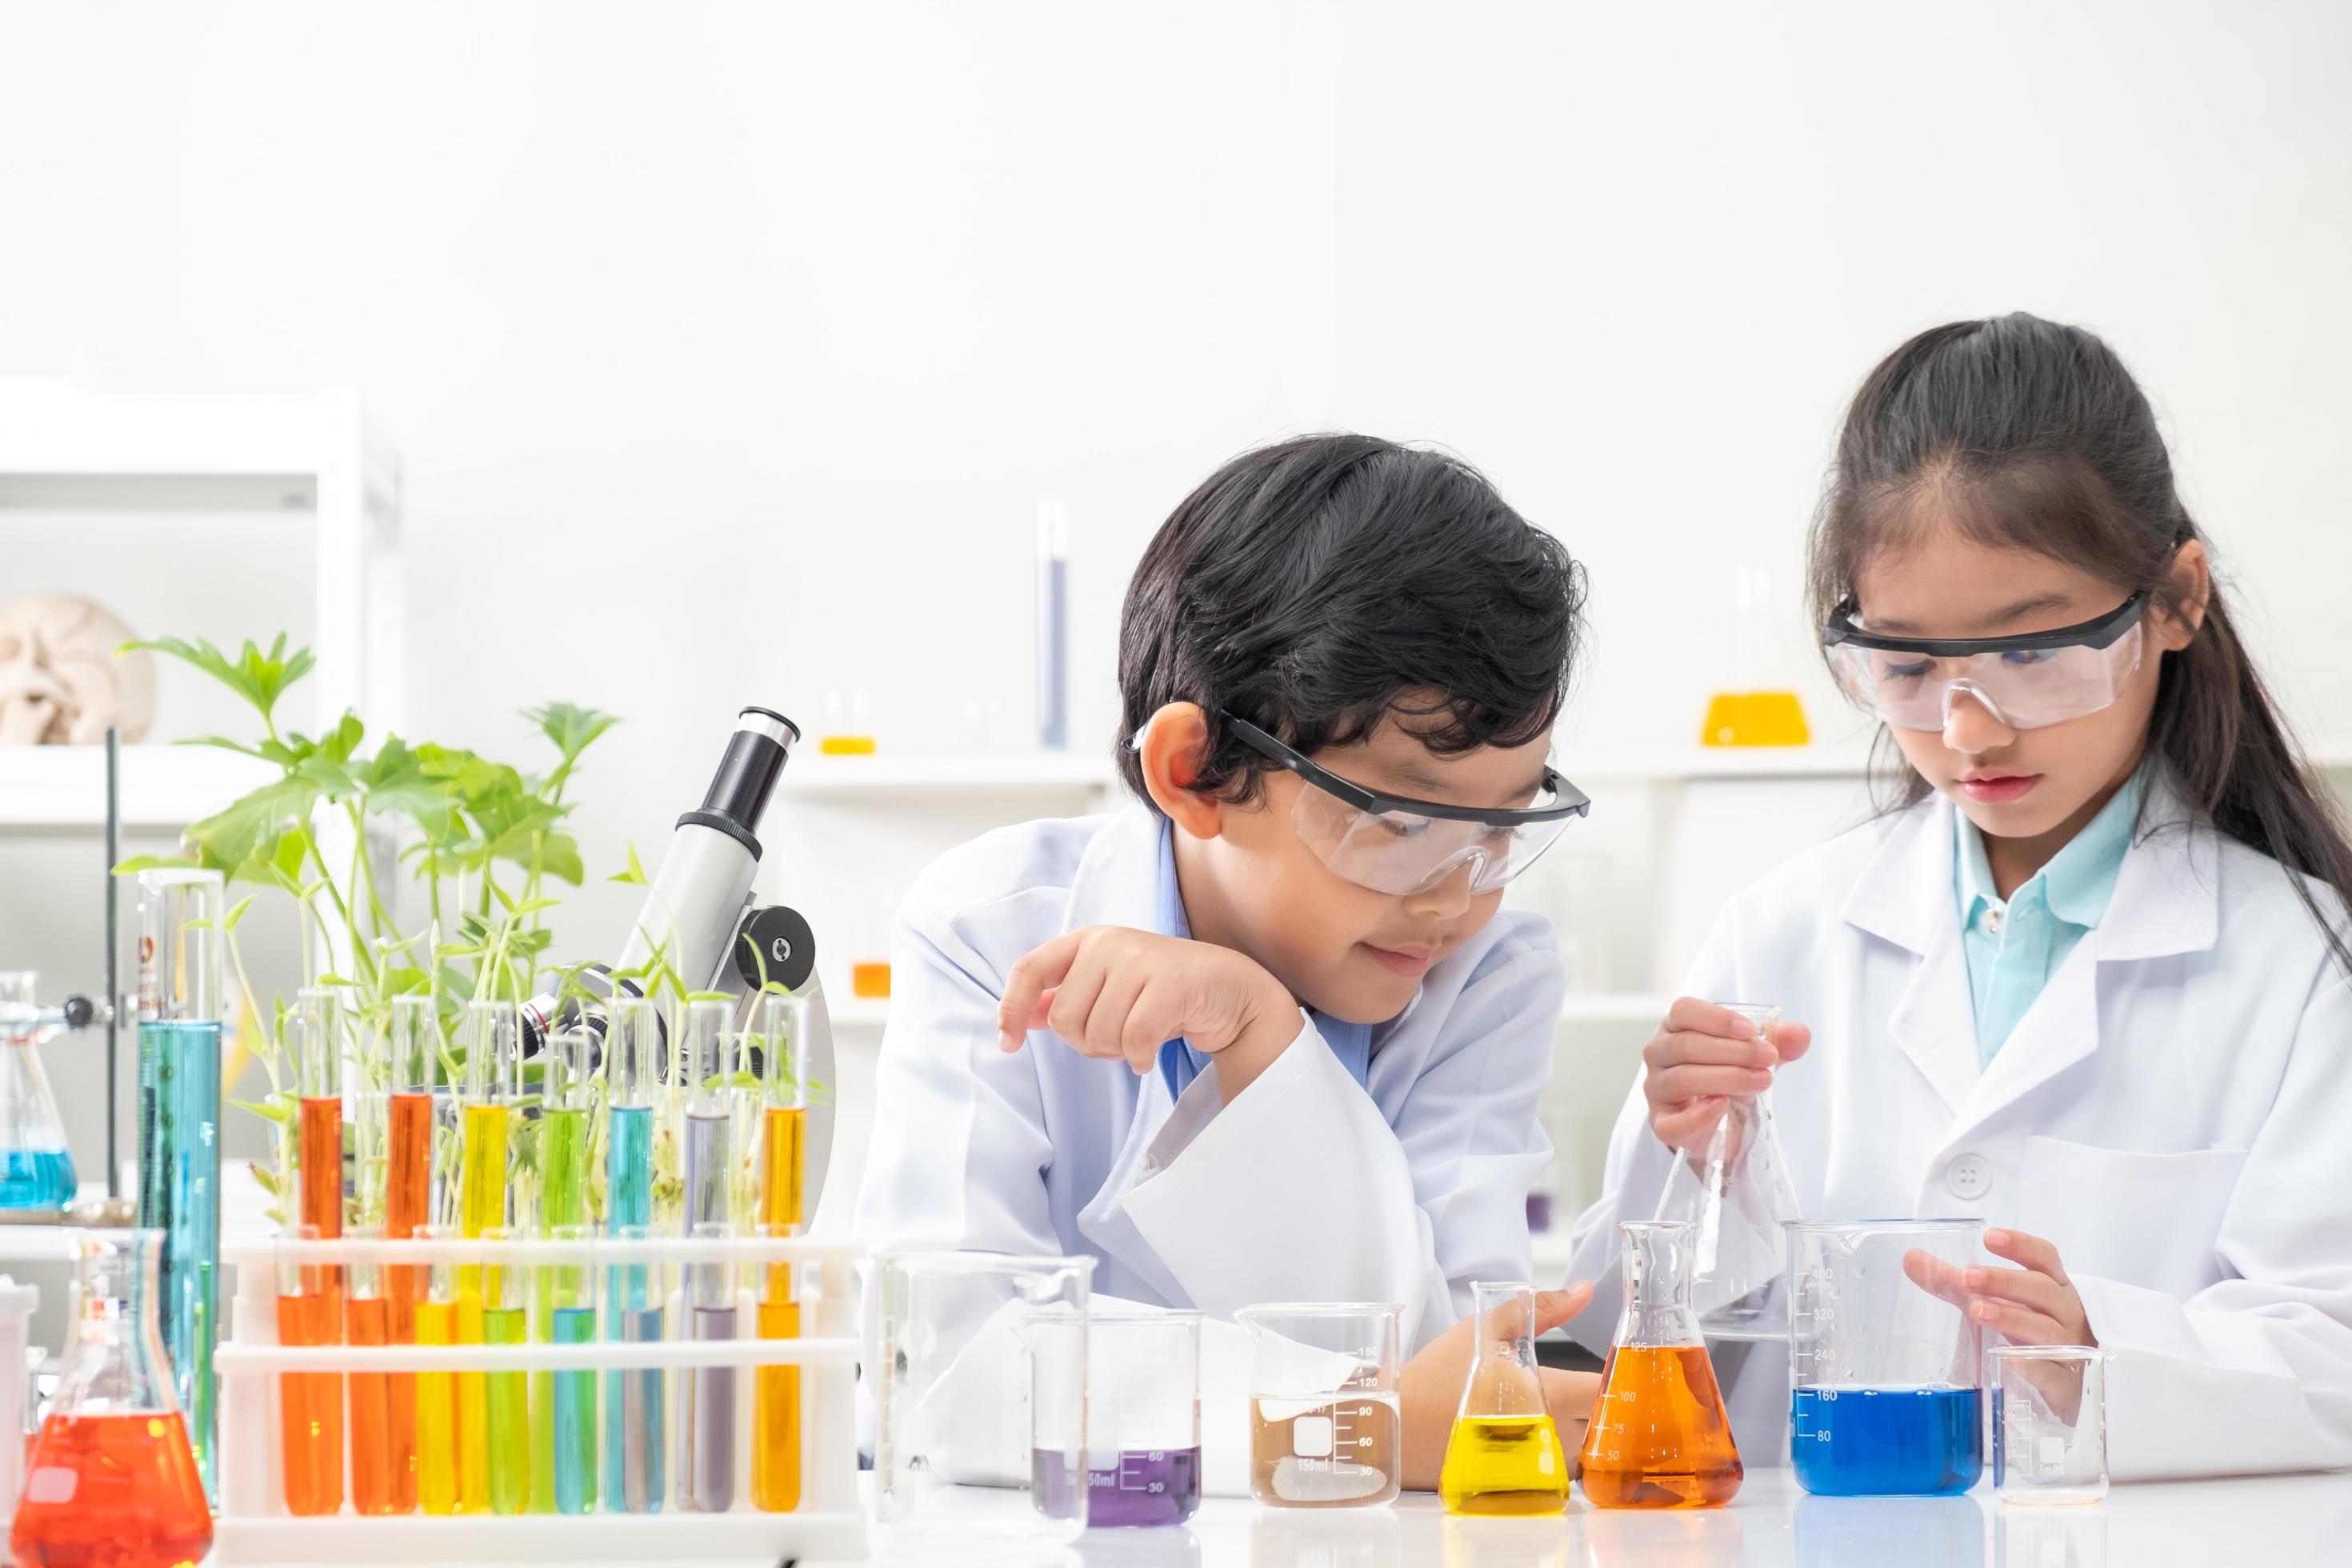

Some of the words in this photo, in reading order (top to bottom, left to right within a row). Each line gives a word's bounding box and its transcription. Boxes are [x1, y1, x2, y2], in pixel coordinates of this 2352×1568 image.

[1812, 1267, 1834, 1279] 400
[1813, 1308, 1834, 1320] 320
[1358, 1347, 1377, 1356] 150
[1630, 1342, 1647, 1352] 125
[1814, 1349, 1836, 1361] 240
[1359, 1378, 1378, 1387] 120
[1620, 1392, 1636, 1402] 100
[1816, 1390, 1838, 1401] 160
[1358, 1406, 1373, 1416] 90
[1613, 1424, 1625, 1434] 75
[1817, 1430, 1831, 1442] 80
[1358, 1437, 1373, 1446] 60
[1148, 1452, 1164, 1462] 60
[1607, 1450, 1619, 1460] 50
[1298, 1458, 1329, 1473] 150ml
[1358, 1466, 1373, 1476] 30
[1148, 1482, 1164, 1493] 30
